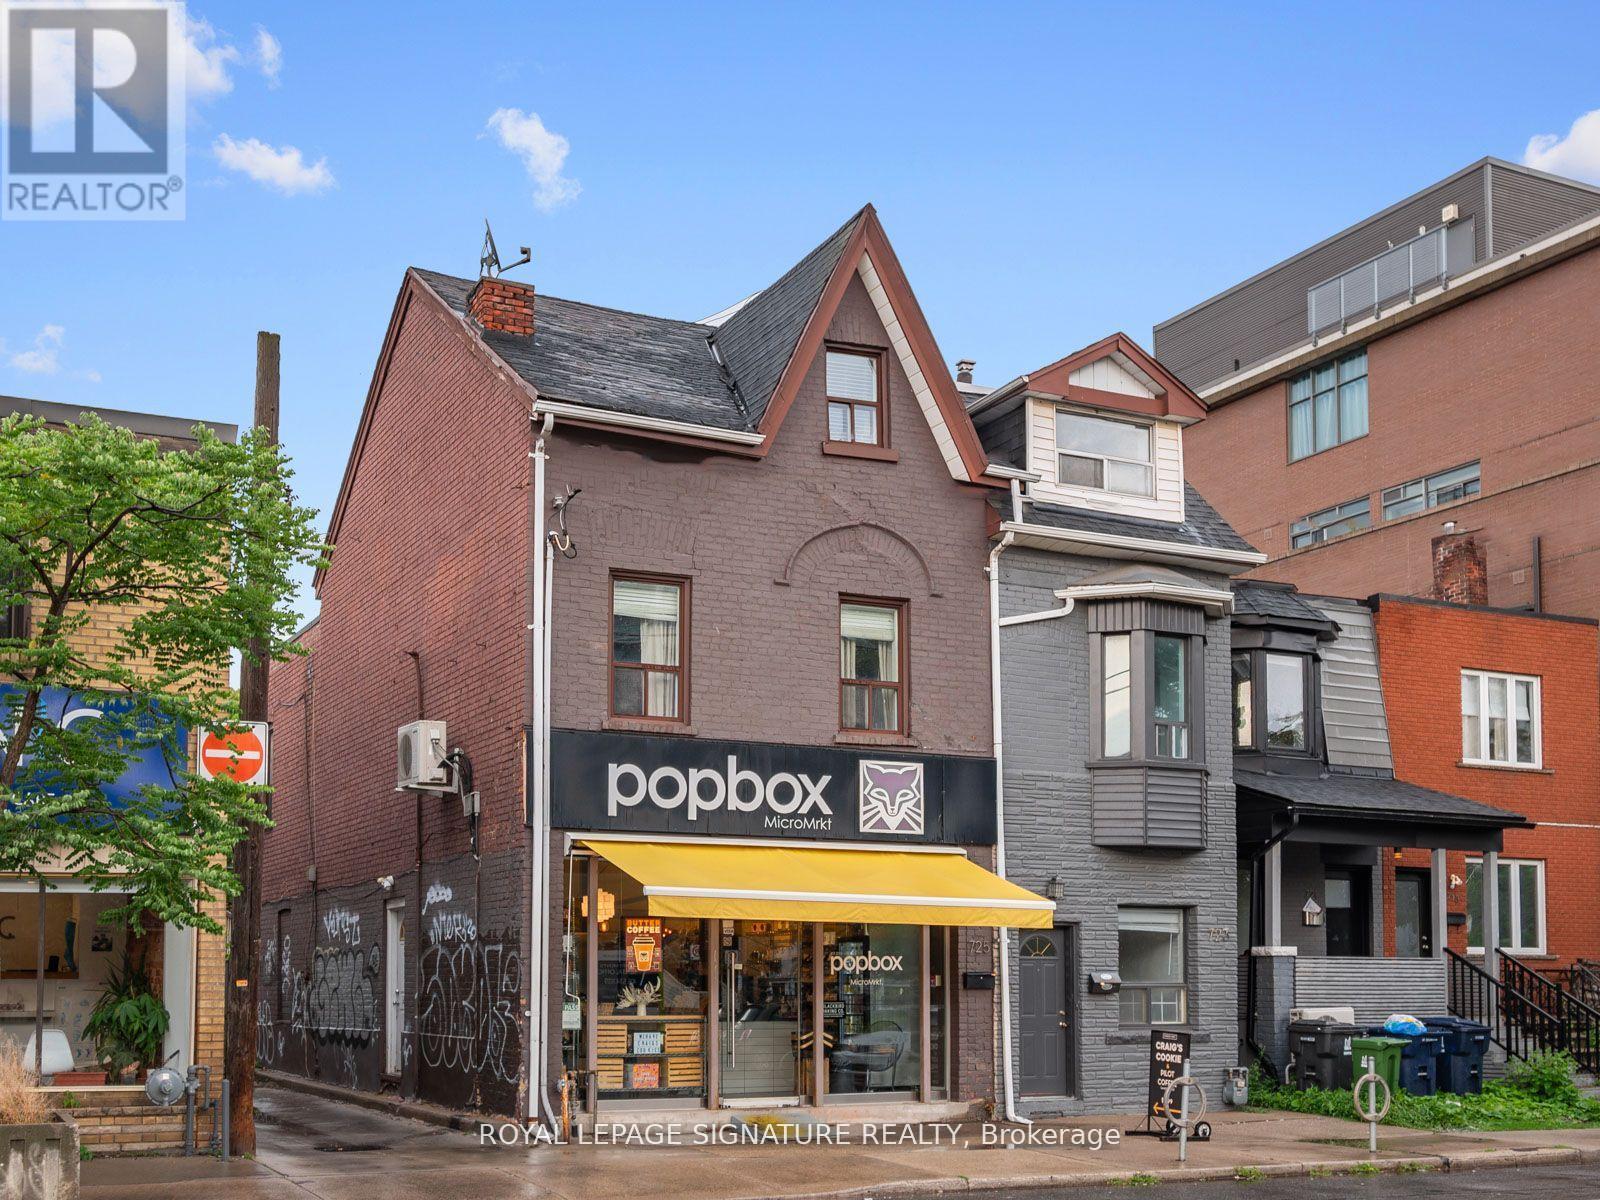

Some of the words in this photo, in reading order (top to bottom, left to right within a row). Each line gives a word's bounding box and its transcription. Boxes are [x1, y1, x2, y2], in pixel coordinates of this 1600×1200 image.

[607, 755, 833, 821] popbox
[764, 815, 832, 831] MicroMrkt
[626, 926, 660, 934] COFFEE
[969, 940, 990, 953] 725
[830, 950, 903, 975] popbox
[1155, 1041, 1184, 1053] CRAIG'S
[1155, 1052, 1182, 1064] COOKIE
[1160, 1069, 1176, 1078] PILOT
